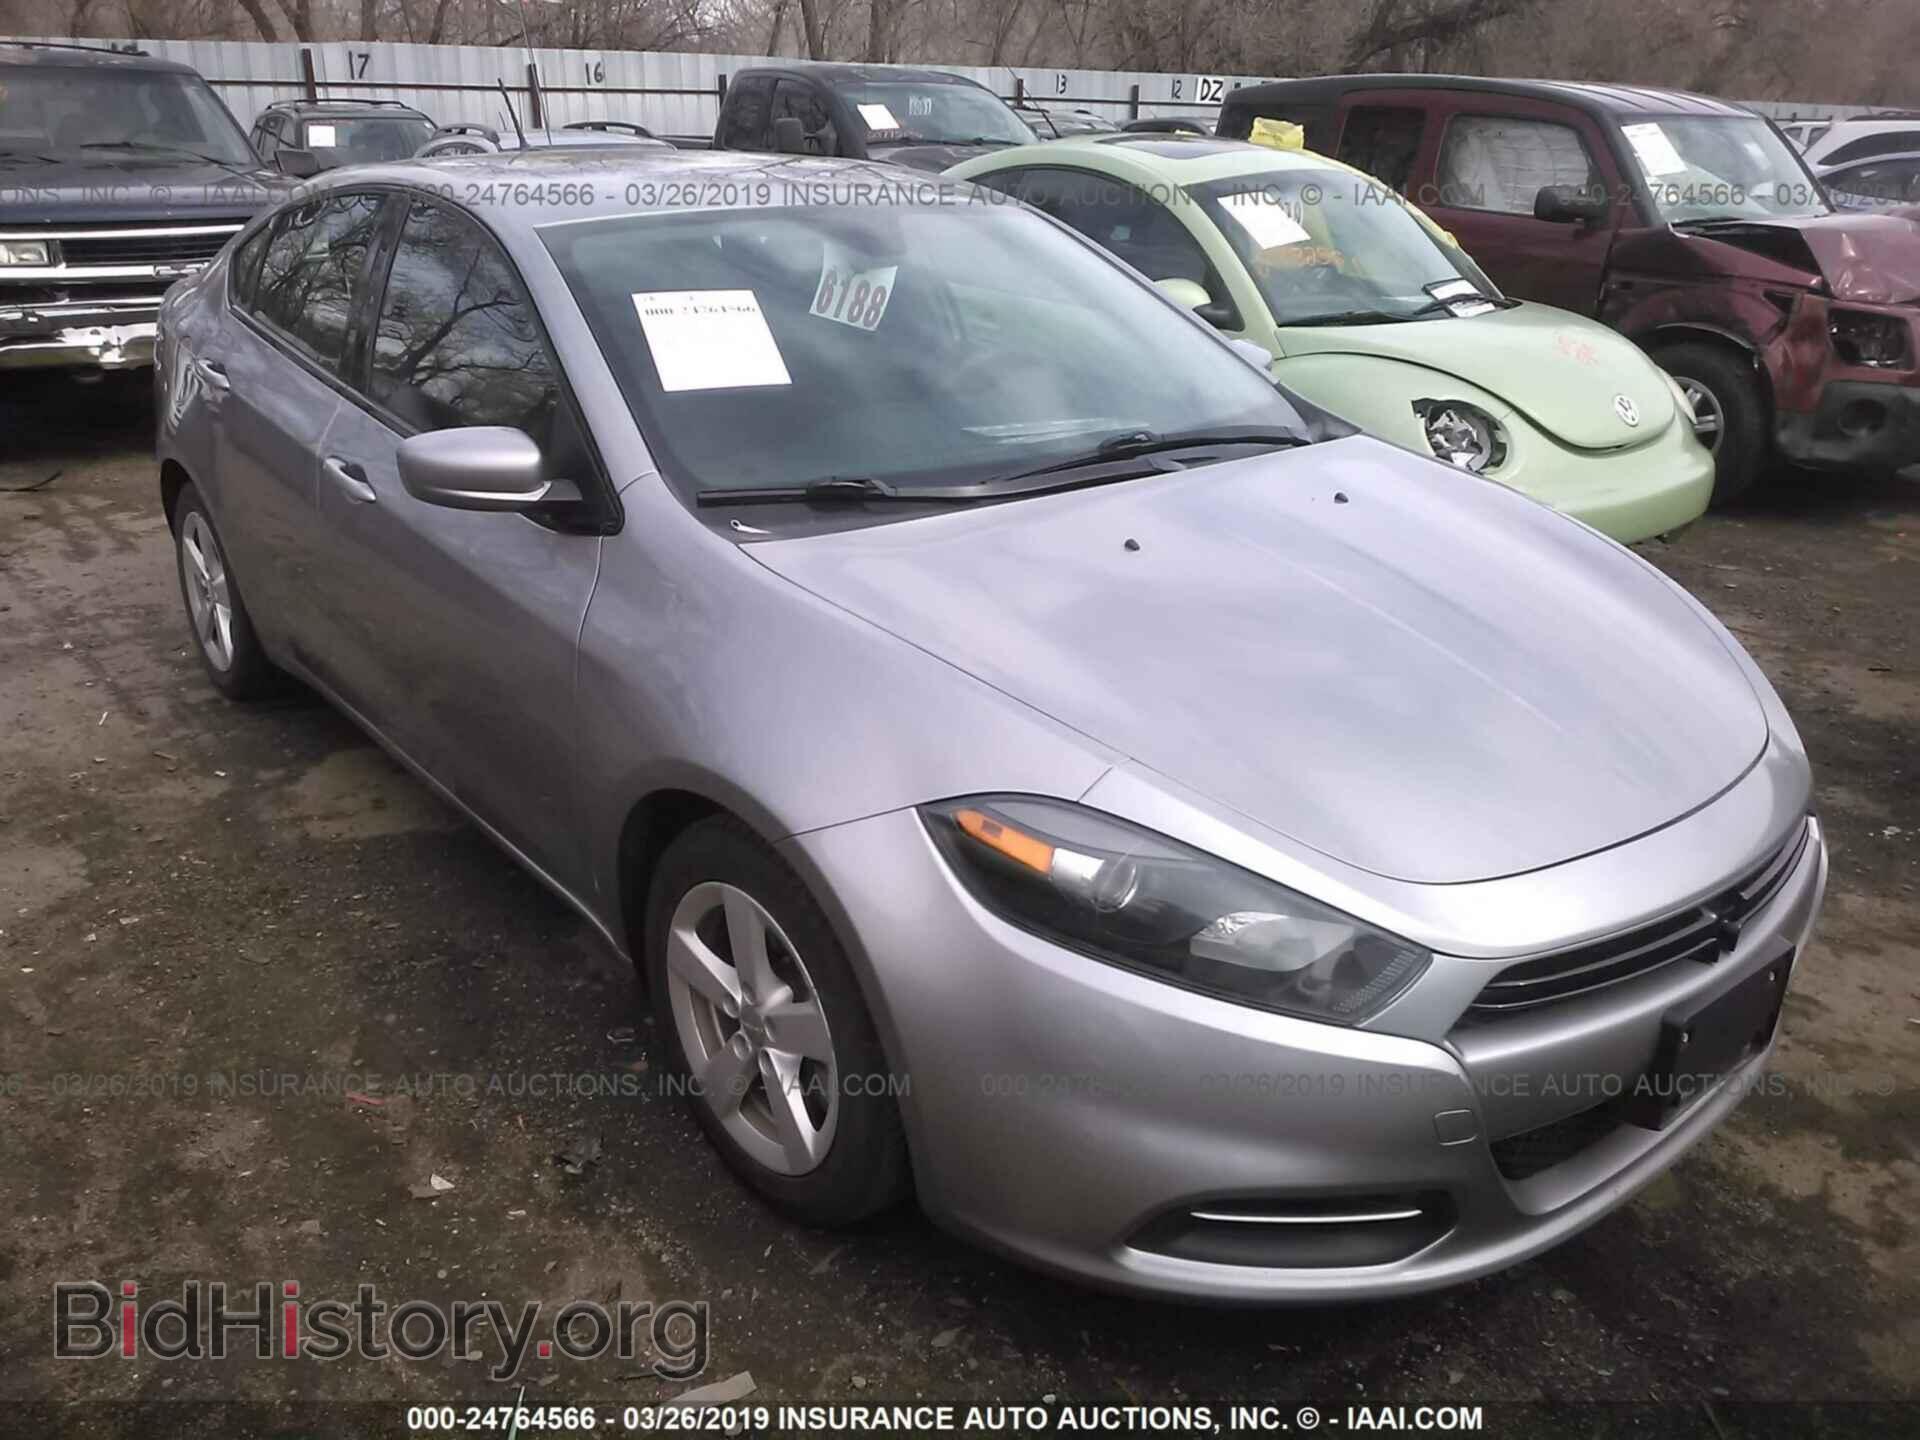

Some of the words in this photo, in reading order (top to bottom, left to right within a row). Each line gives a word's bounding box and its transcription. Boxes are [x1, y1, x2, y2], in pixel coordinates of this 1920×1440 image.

[348, 50, 370, 80] 17
[585, 61, 605, 86] 16
[1056, 74, 1067, 94] 13
[1171, 79, 1182, 99] 12
[1201, 78, 1223, 103] DZ
